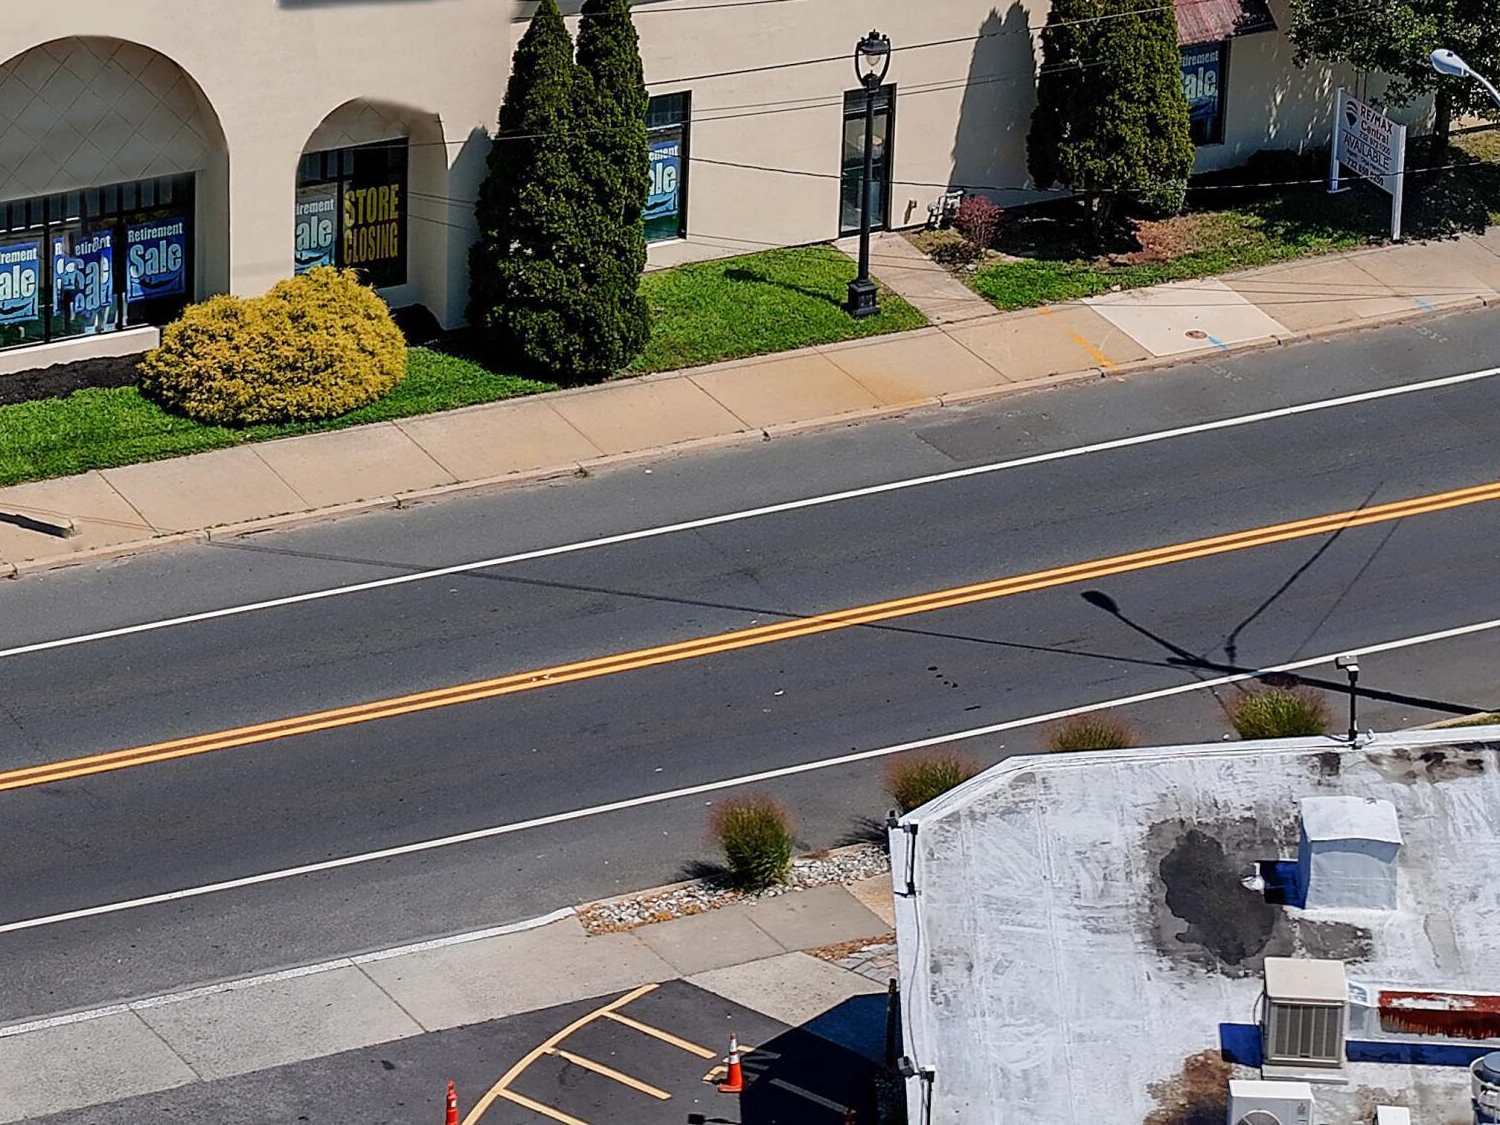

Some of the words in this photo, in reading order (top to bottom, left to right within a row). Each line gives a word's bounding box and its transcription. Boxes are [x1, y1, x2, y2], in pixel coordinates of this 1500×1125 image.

[1180, 51, 1219, 67] tirement
[1360, 104, 1393, 135] RE/MAX
[1361, 120, 1390, 145] Central
[649, 145, 679, 161] ement
[1343, 132, 1392, 171] AVAILABLE
[296, 198, 335, 215] irement
[344, 183, 399, 227] STORE
[128, 222, 185, 242] Retirement
[296, 216, 333, 251] ale
[343, 222, 399, 265] CLOSING
[130, 240, 183, 278] Sale
